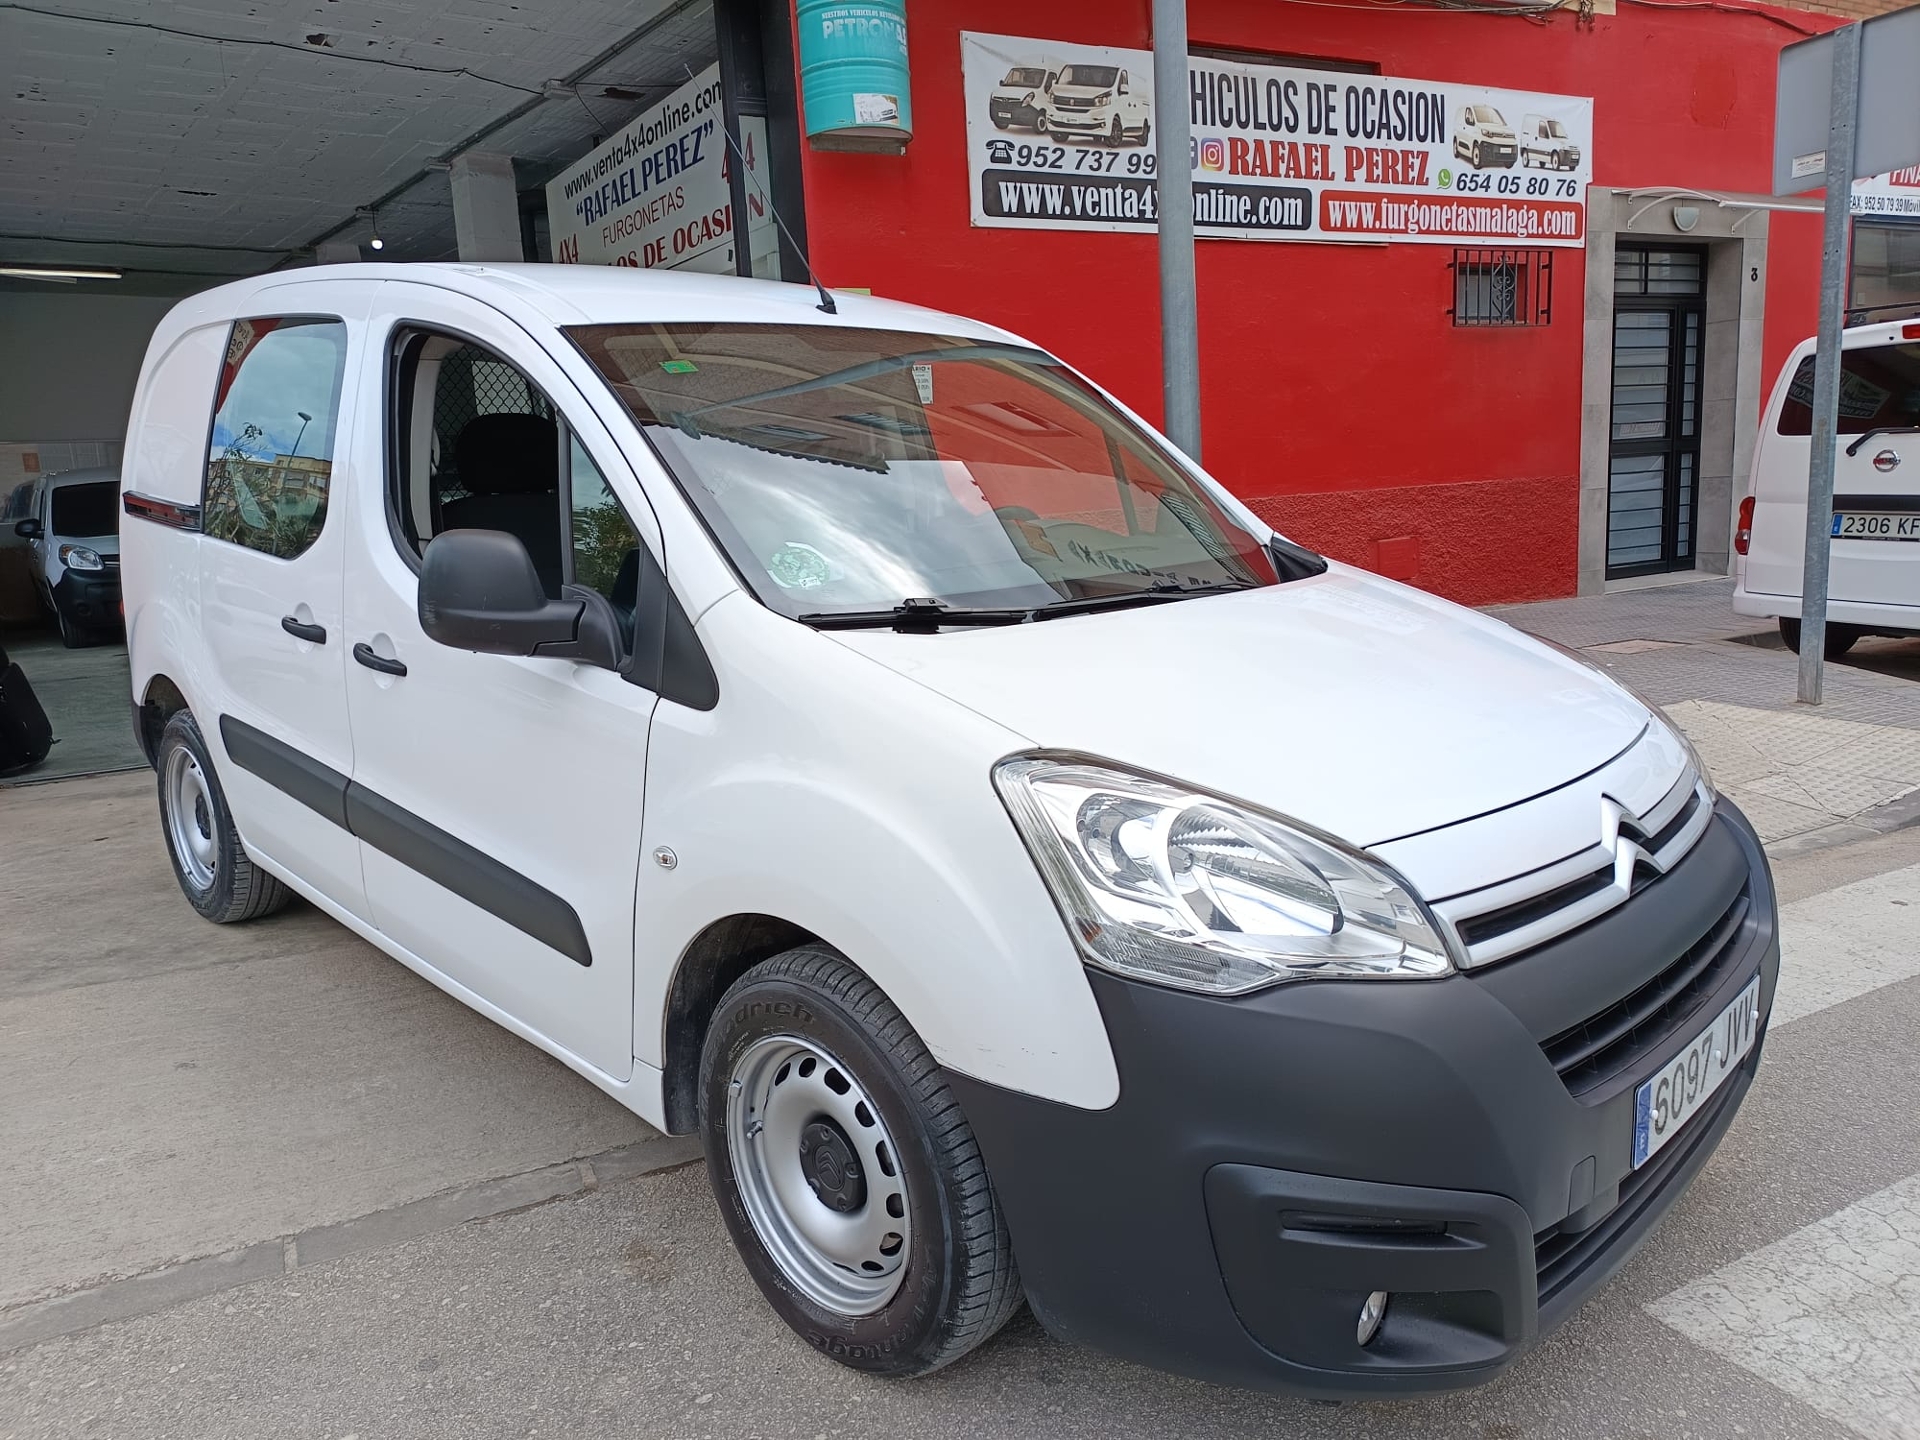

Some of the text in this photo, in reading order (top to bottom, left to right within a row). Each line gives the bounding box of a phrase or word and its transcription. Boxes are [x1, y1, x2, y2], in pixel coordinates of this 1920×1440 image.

[1190, 69, 1445, 144] HICULOS DE OCASION
[1016, 144, 1157, 175] 952 737 99
[1228, 137, 1429, 186] RAFAEL PEREZ
[999, 180, 1303, 227] www.venta4nline.com
[1456, 172, 1577, 197] 654 05 80 76
[602, 186, 685, 248] FURGONETAS
[1328, 198, 1576, 238] www.furgonetasmalaga.com
[643, 235, 668, 269] DE
[1751, 267, 1758, 282] 3
[1843, 516, 1891, 534] 2306
[1654, 1031, 1713, 1135] 6097
